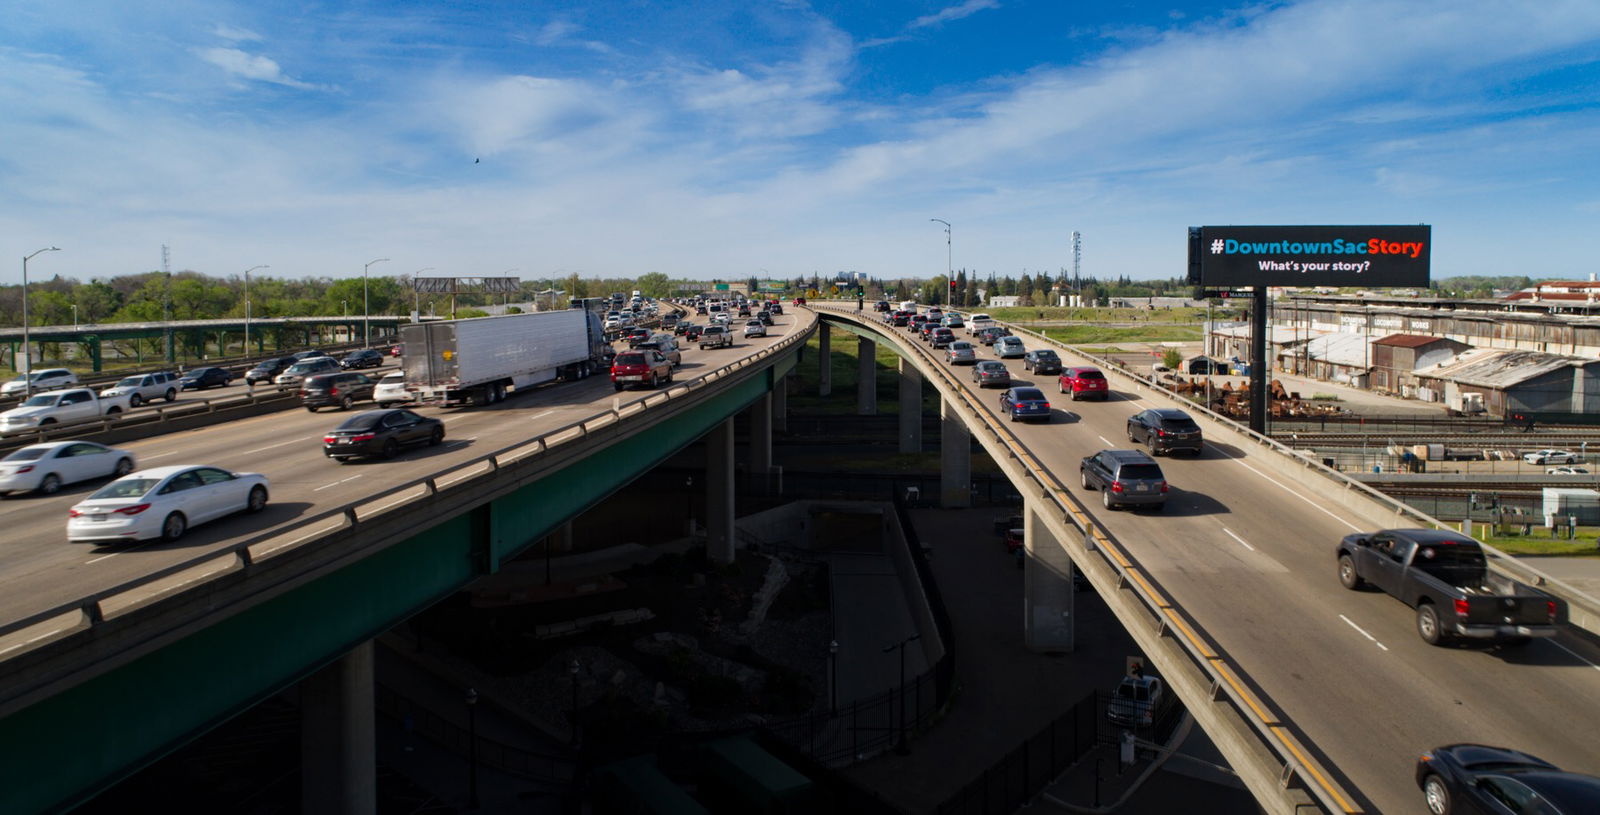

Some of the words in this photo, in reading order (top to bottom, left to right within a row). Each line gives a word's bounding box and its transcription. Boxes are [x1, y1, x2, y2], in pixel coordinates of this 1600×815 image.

[1211, 238, 1424, 259] #DowntownSacStory
[1258, 260, 1300, 271] What's
[1301, 262, 1331, 273] your
[1332, 260, 1371, 273] story?
